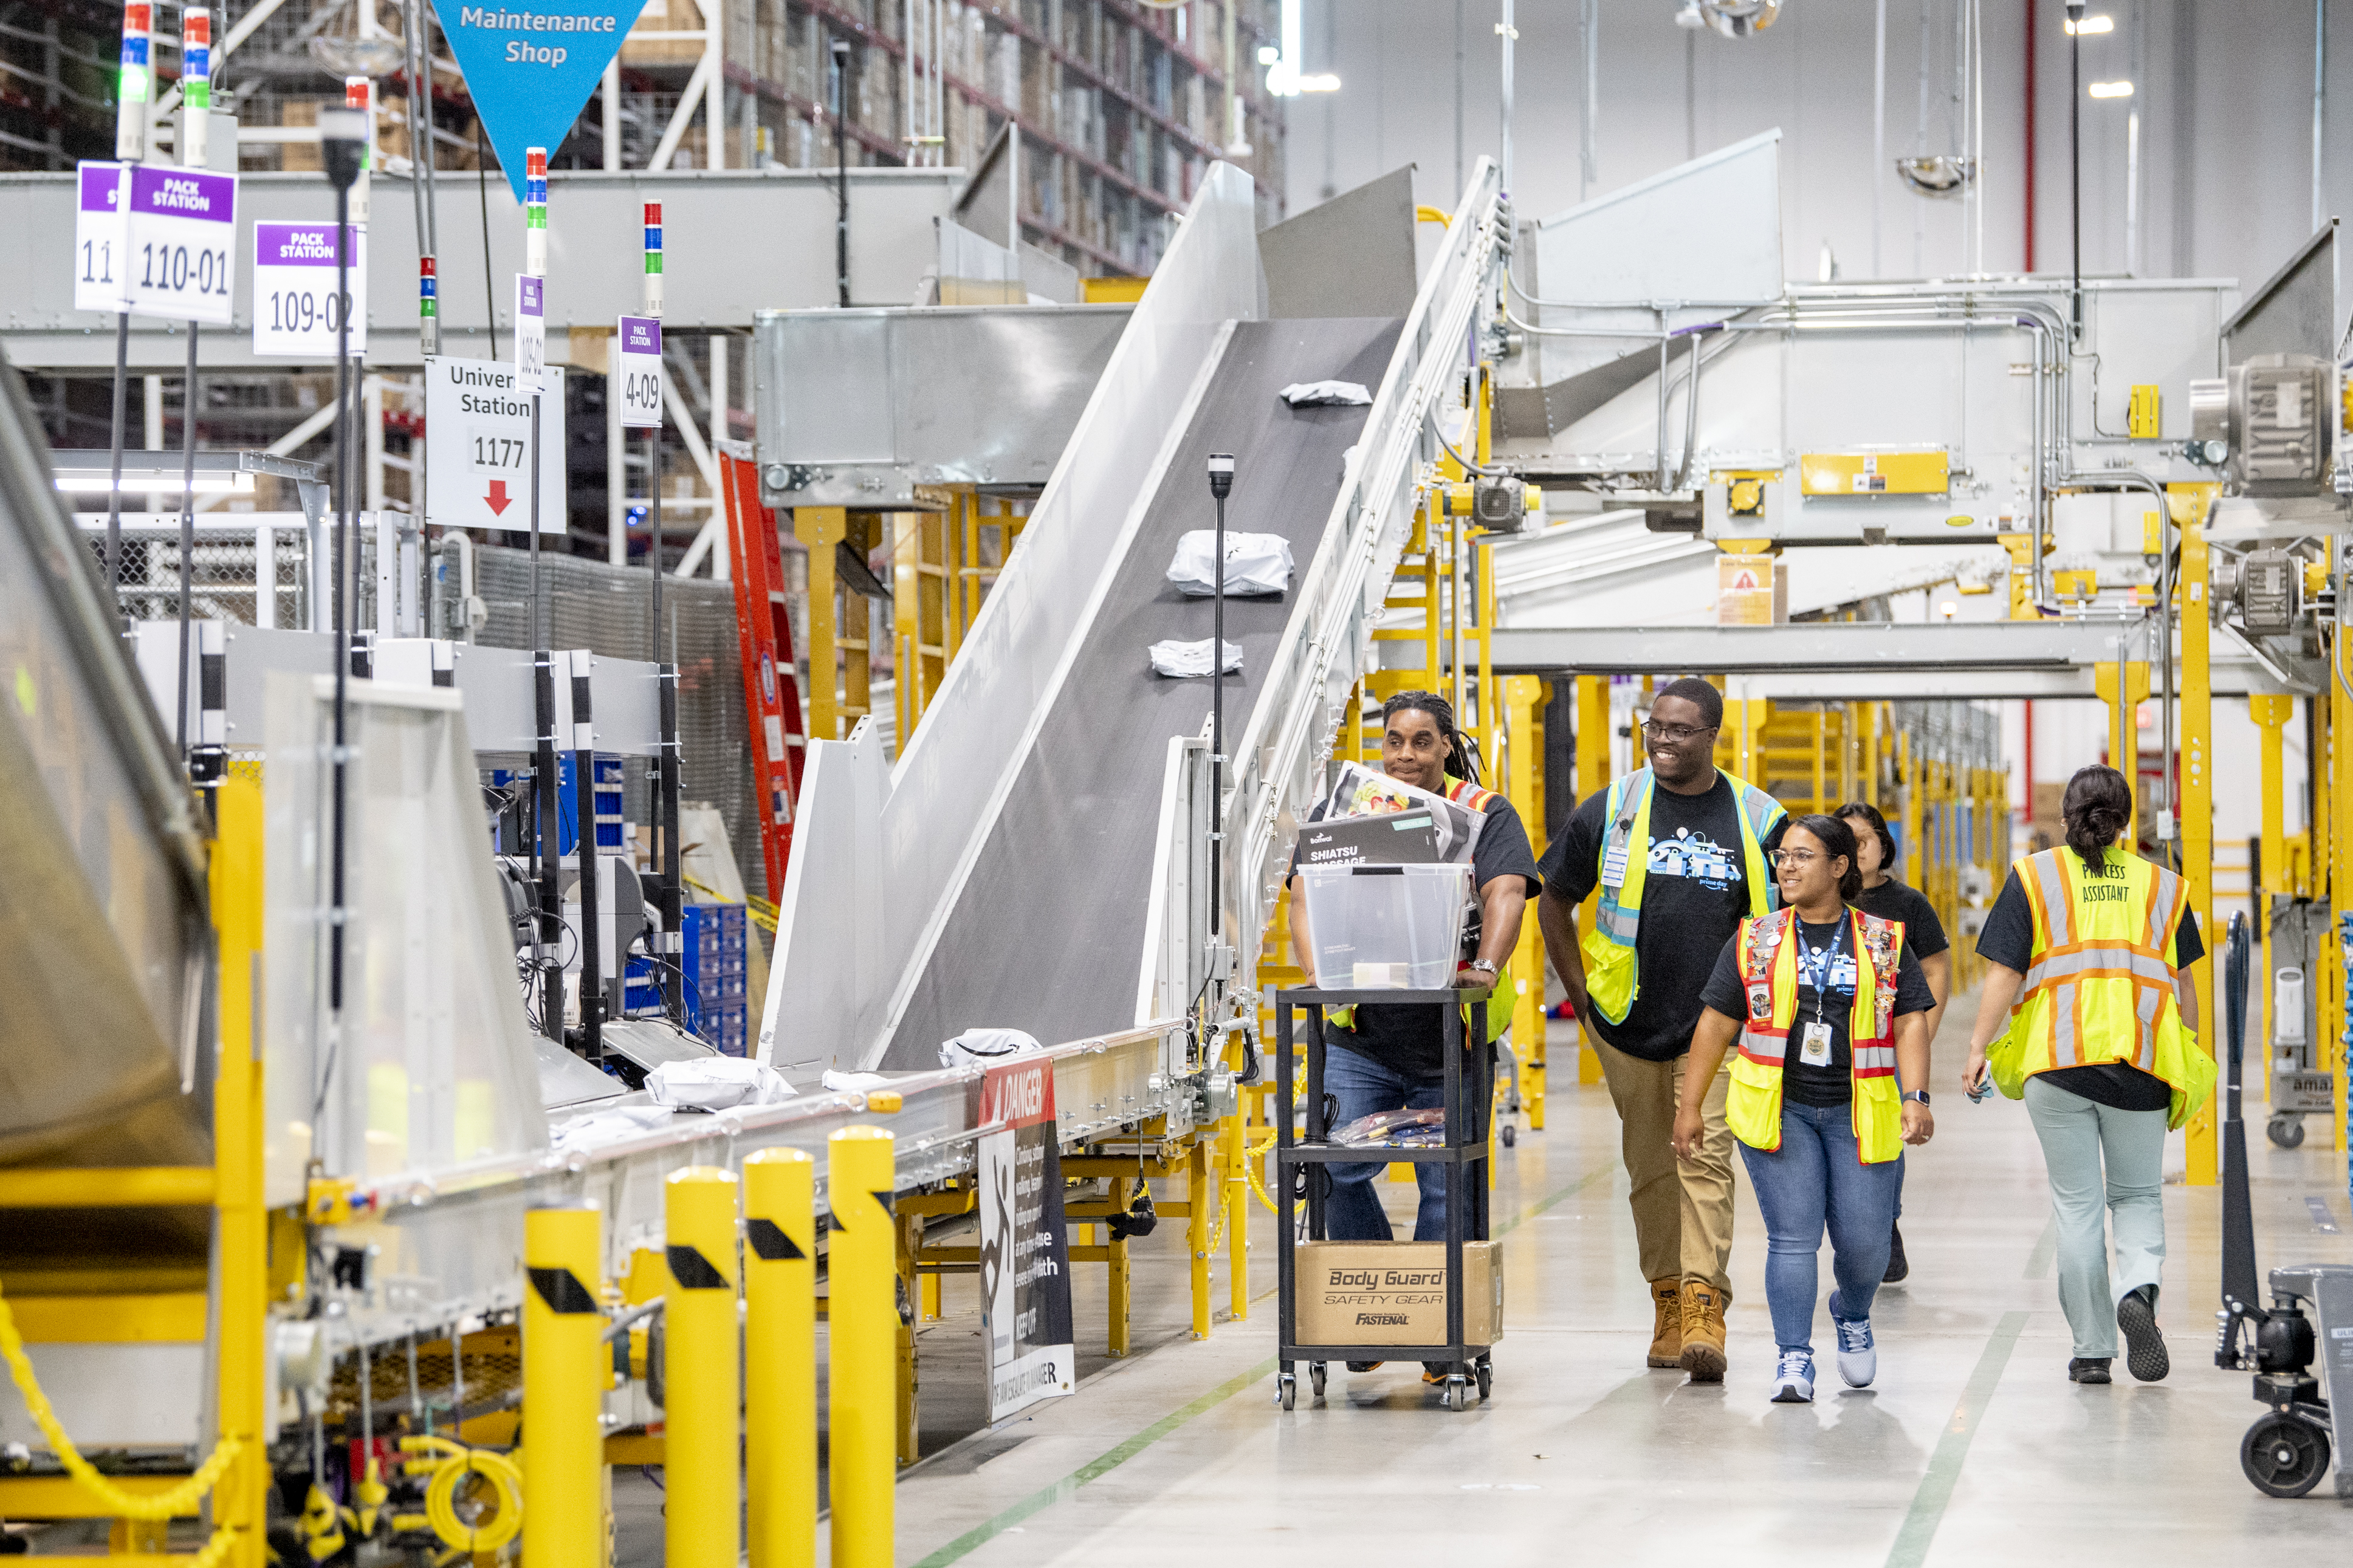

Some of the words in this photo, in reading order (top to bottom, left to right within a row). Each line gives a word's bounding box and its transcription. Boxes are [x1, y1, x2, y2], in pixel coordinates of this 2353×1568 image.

[460, 5, 616, 32] Maintenance
[504, 39, 568, 69] Shop
[164, 178, 199, 196] PACK
[153, 190, 210, 212] STATION
[290, 233, 324, 245] PACK
[280, 245, 334, 258] STATION
[141, 242, 227, 295] 110-01
[524, 295, 537, 307] STATION
[271, 291, 354, 333] 109-02
[633, 326, 647, 335] PACK
[630, 336, 651, 346] STATION
[451, 366, 515, 388] Univer
[626, 372, 658, 409] 4-09
[461, 394, 530, 417] Station
[475, 436, 524, 468] 1177
[1311, 846, 1358, 861] SHIATSU
[2082, 864, 2126, 879] PCESS
[2083, 885, 2129, 903] ASSISTANT
[2293, 1079, 2334, 1090] ama
[1003, 1068, 1042, 1122] DANGER
[1329, 1271, 1378, 1290] Body
[1385, 1271, 1443, 1285] Guard
[1324, 1295, 1390, 1304] SAFETY
[1395, 1295, 1443, 1304] GEAR
[1016, 1312, 1028, 1341] KEEP
[1028, 1307, 1037, 1335] OFF
[1355, 1313, 1409, 1325] FASTENAL
[1008, 1372, 1026, 1401] ESCALATE
[1030, 1362, 1057, 1390] MANAGER
